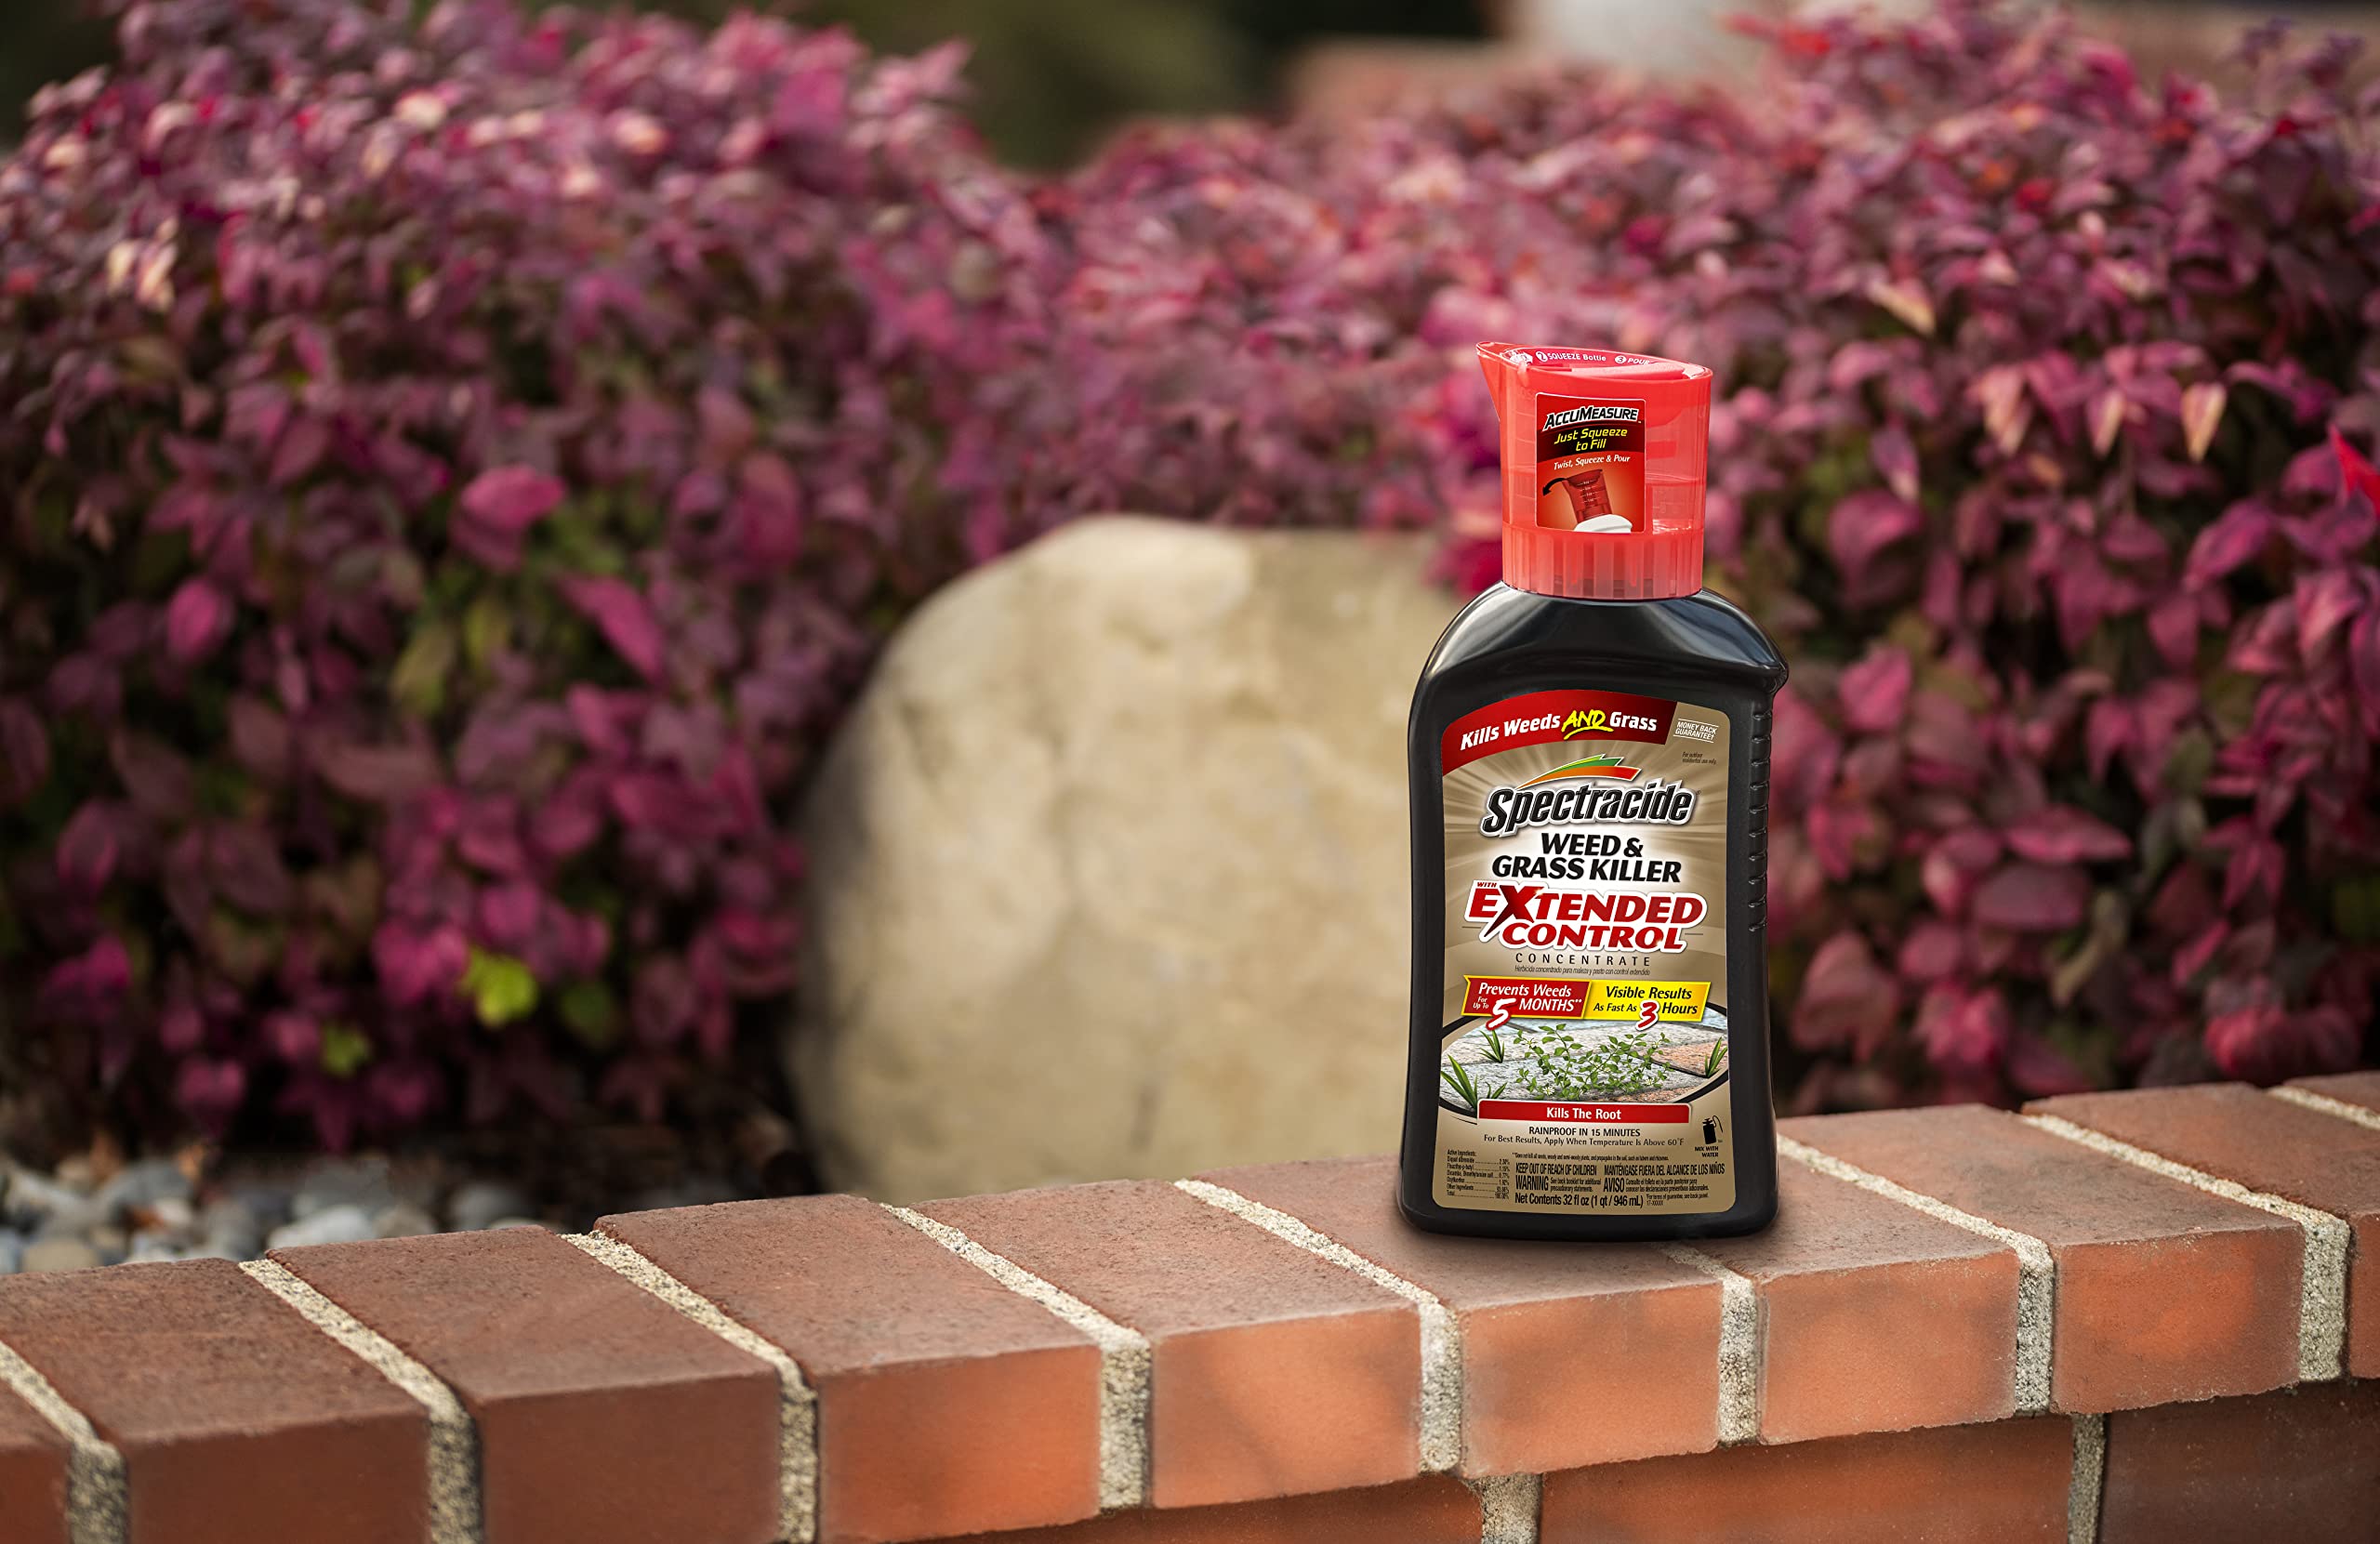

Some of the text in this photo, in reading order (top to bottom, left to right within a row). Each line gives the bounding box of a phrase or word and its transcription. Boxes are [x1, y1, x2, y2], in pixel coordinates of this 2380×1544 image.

[1547, 352, 1580, 361] SQUEEZE
[1582, 353, 1606, 362] Bottle
[1627, 357, 1650, 365] POUR
[1554, 428, 1628, 444] Just Squeeze
[1575, 439, 1606, 452] to Fill
[1554, 454, 1631, 470] Twist, Squeeze & Pour
[1460, 708, 1658, 751] Kills Weeds AND Grass
[1676, 721, 1717, 735] MONEY BACK
[1481, 781, 1695, 835] Spectracide
[1540, 832, 1644, 858] WEED &
[1491, 854, 1682, 883] GRASS KILLER
[1468, 884, 1703, 935] EXTENDED
[1501, 921, 1686, 950] CONTROL
[1514, 952, 1650, 967] CONCENTRATE
[1477, 982, 1572, 997] Prevents Weeds
[1606, 985, 1692, 999] Visible Results
[1488, 997, 1516, 1028] 5
[1593, 1001, 1699, 1029] As Fast As 3 Hours
[1546, 1106, 1621, 1120] Kills The Root
[1528, 1126, 1641, 1137] RAINPROOF IN 15 MINUTES
[1484, 1134, 1496, 1142] For
[1498, 1134, 1514, 1143] Best
[1515, 1135, 1542, 1144] Results,
[1543, 1136, 1565, 1147] Apply
[1566, 1137, 1587, 1145] When
[1589, 1138, 1635, 1148] Temperature
[1635, 1138, 1642, 1146] Is
[1643, 1138, 1666, 1146] Above
[1515, 1162, 1528, 1174] KEEP
[1528, 1163, 1540, 1174] OUT
[1540, 1163, 1547, 1174] OF
[1548, 1164, 1564, 1175] REACH
[1565, 1164, 1571, 1175] OF
[1572, 1164, 1597, 1176] CHILDREN
[1639, 1165, 1655, 1176] FUERA
[1656, 1165, 1665, 1176] DEL
[1666, 1164, 1689, 1176] ALCANCE
[1690, 1164, 1698, 1175] DE
[1698, 1164, 1708, 1175] LOS
[1515, 1174, 1549, 1191] WARNING
[1603, 1177, 1625, 1193] AVISO
[1514, 1192, 1527, 1204] Net
[1528, 1193, 1562, 1206] Contents
[1563, 1194, 1572, 1206] 32
[1574, 1194, 1580, 1206] fl
[1580, 1196, 1589, 1206] oz
[1591, 1194, 1597, 1208] (1
[1599, 1194, 1608, 1208] qt
[1608, 1194, 1613, 1207] /
[1613, 1194, 1628, 1207] 946
[1629, 1194, 1644, 1208] mL)
